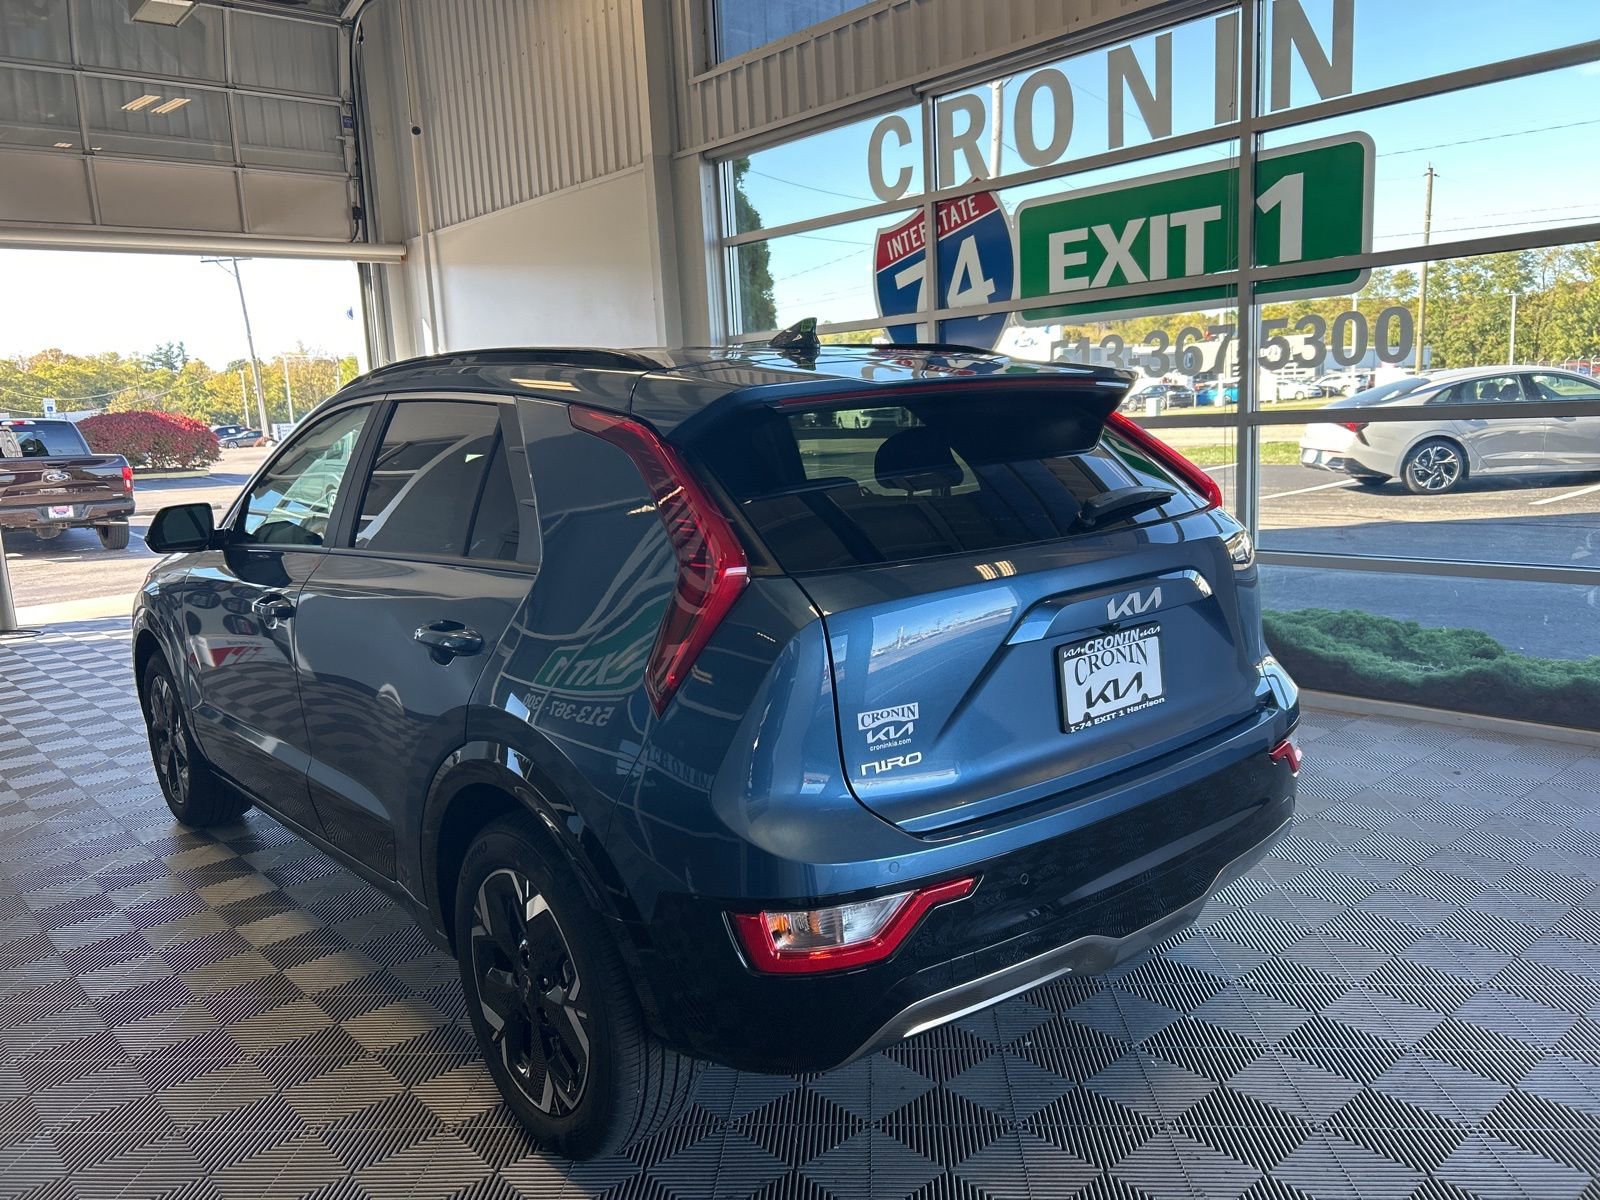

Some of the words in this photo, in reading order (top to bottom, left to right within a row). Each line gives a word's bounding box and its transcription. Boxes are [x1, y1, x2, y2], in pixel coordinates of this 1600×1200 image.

[868, 0, 1355, 202] CRONIN
[886, 194, 980, 261] INTERTATE
[1048, 205, 1222, 293] EXIT
[1256, 172, 1305, 264] 1
[894, 234, 996, 344] 74
[1106, 586, 1162, 620] KIA
[1085, 629, 1140, 654] CRONIN
[1074, 640, 1149, 686] CRONIN
[1085, 671, 1143, 709] KIA
[860, 705, 916, 728] CRONIN
[866, 721, 914, 744] KIA
[1070, 721, 1092, 733] I-74
[1094, 713, 1117, 726] EXIT
[1118, 709, 1125, 717] 1
[1127, 697, 1165, 714] Harrison
[869, 738, 912, 752] croninkia.com
